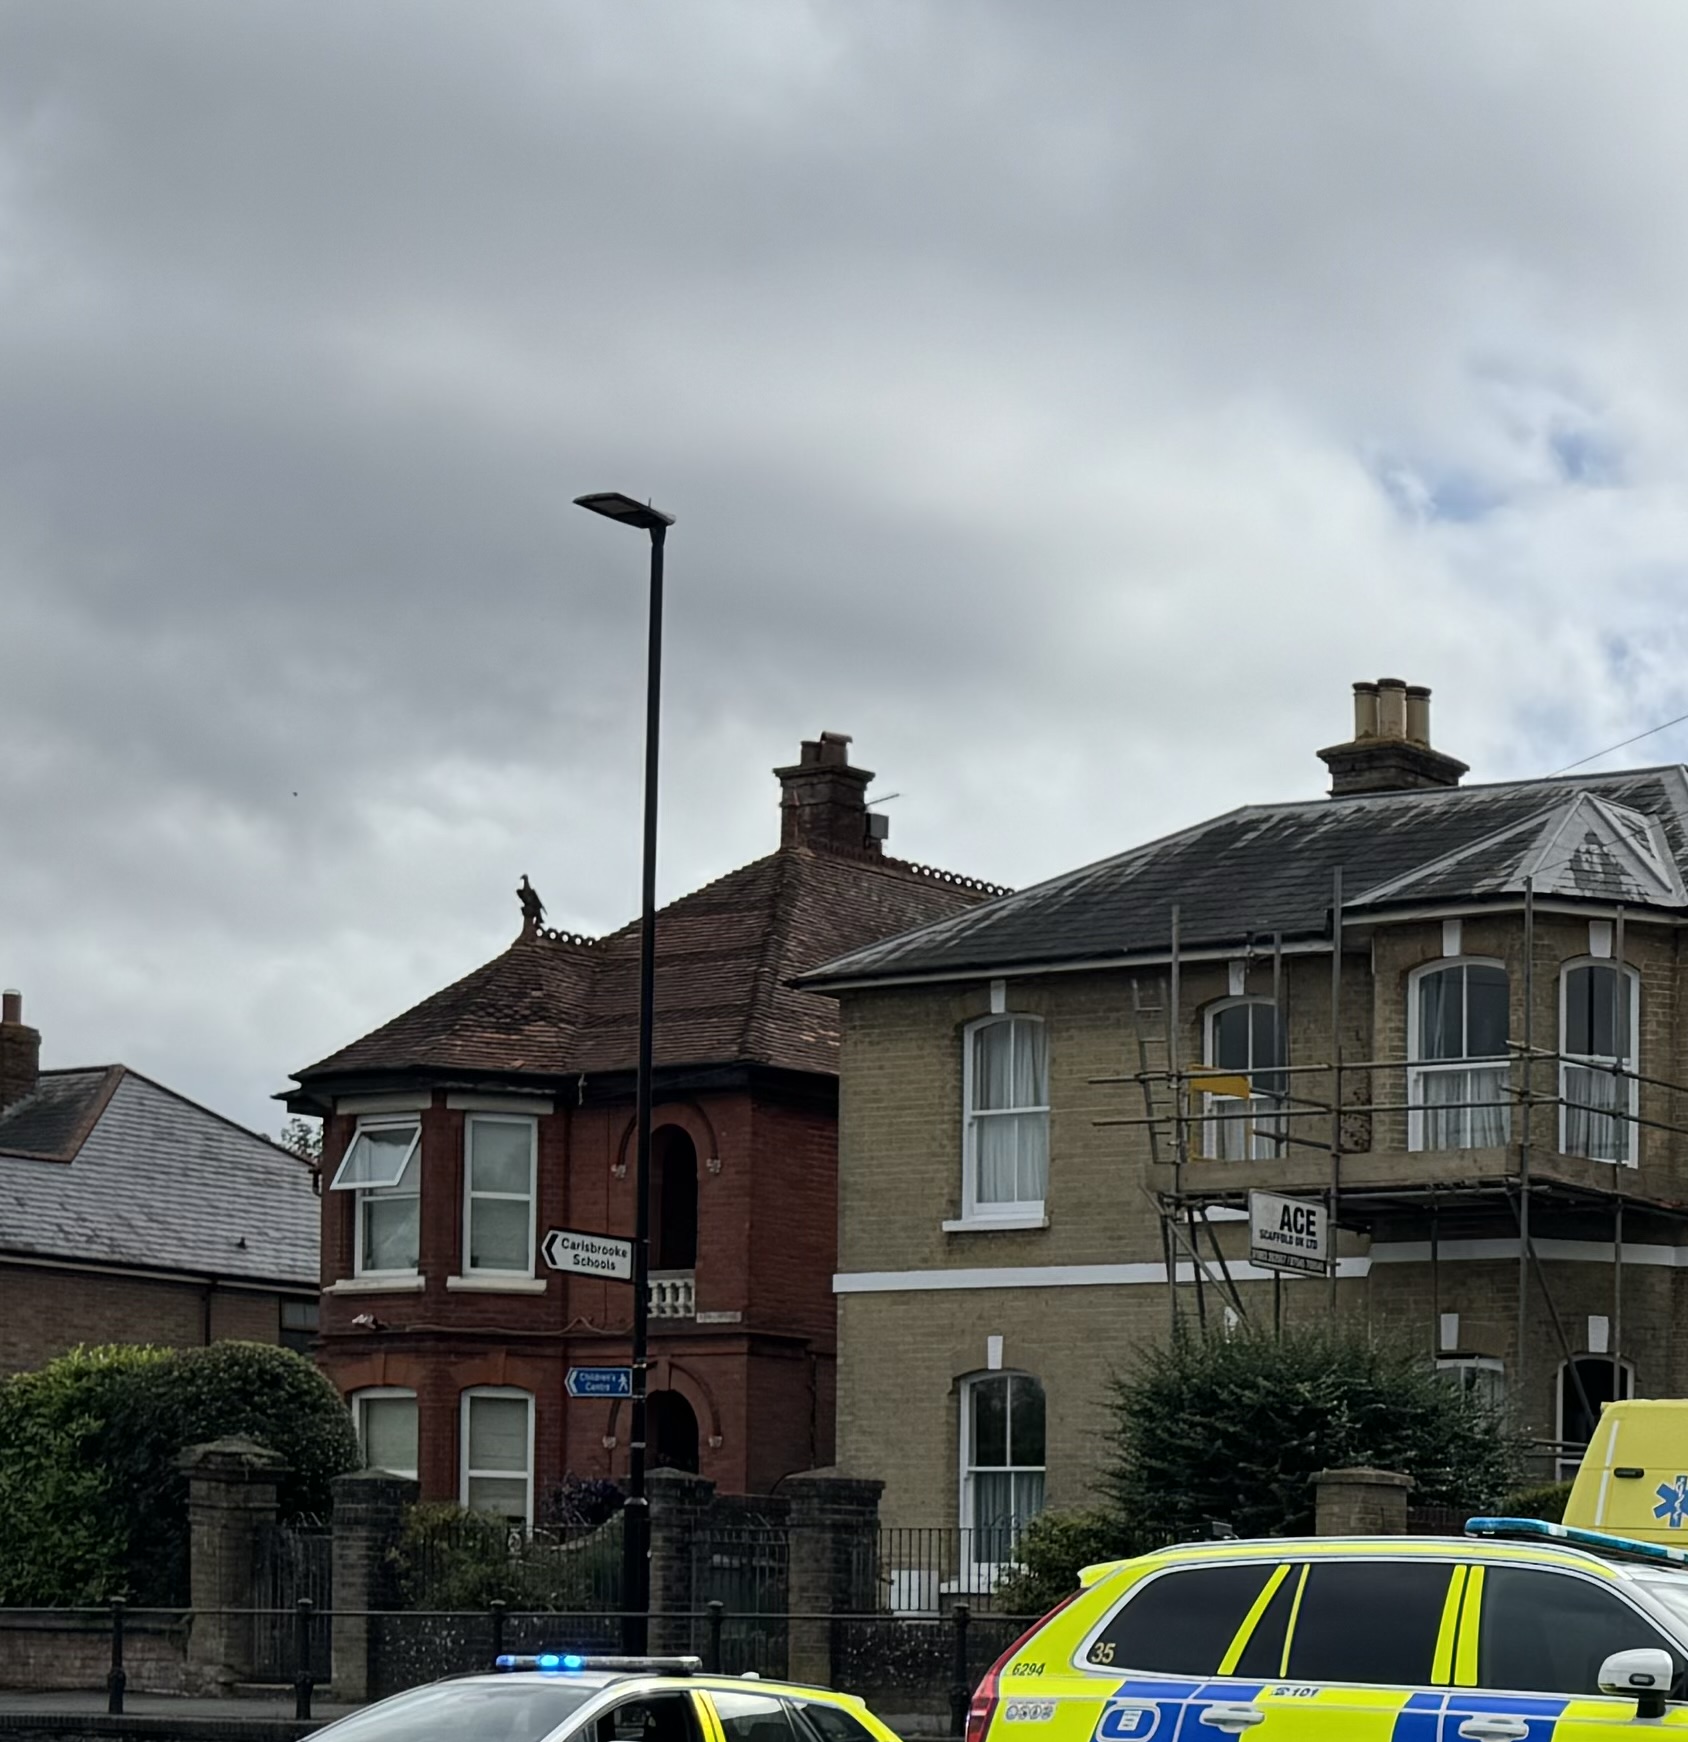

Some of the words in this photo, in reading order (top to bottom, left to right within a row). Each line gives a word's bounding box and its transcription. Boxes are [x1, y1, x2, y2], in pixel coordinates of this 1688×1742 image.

[1280, 1204, 1317, 1238] ACE
[573, 1253, 616, 1271] Schools
[1091, 1642, 1116, 1663] 35
[1012, 1662, 1046, 1677] 6294
[1292, 1687, 1320, 1698] 101
